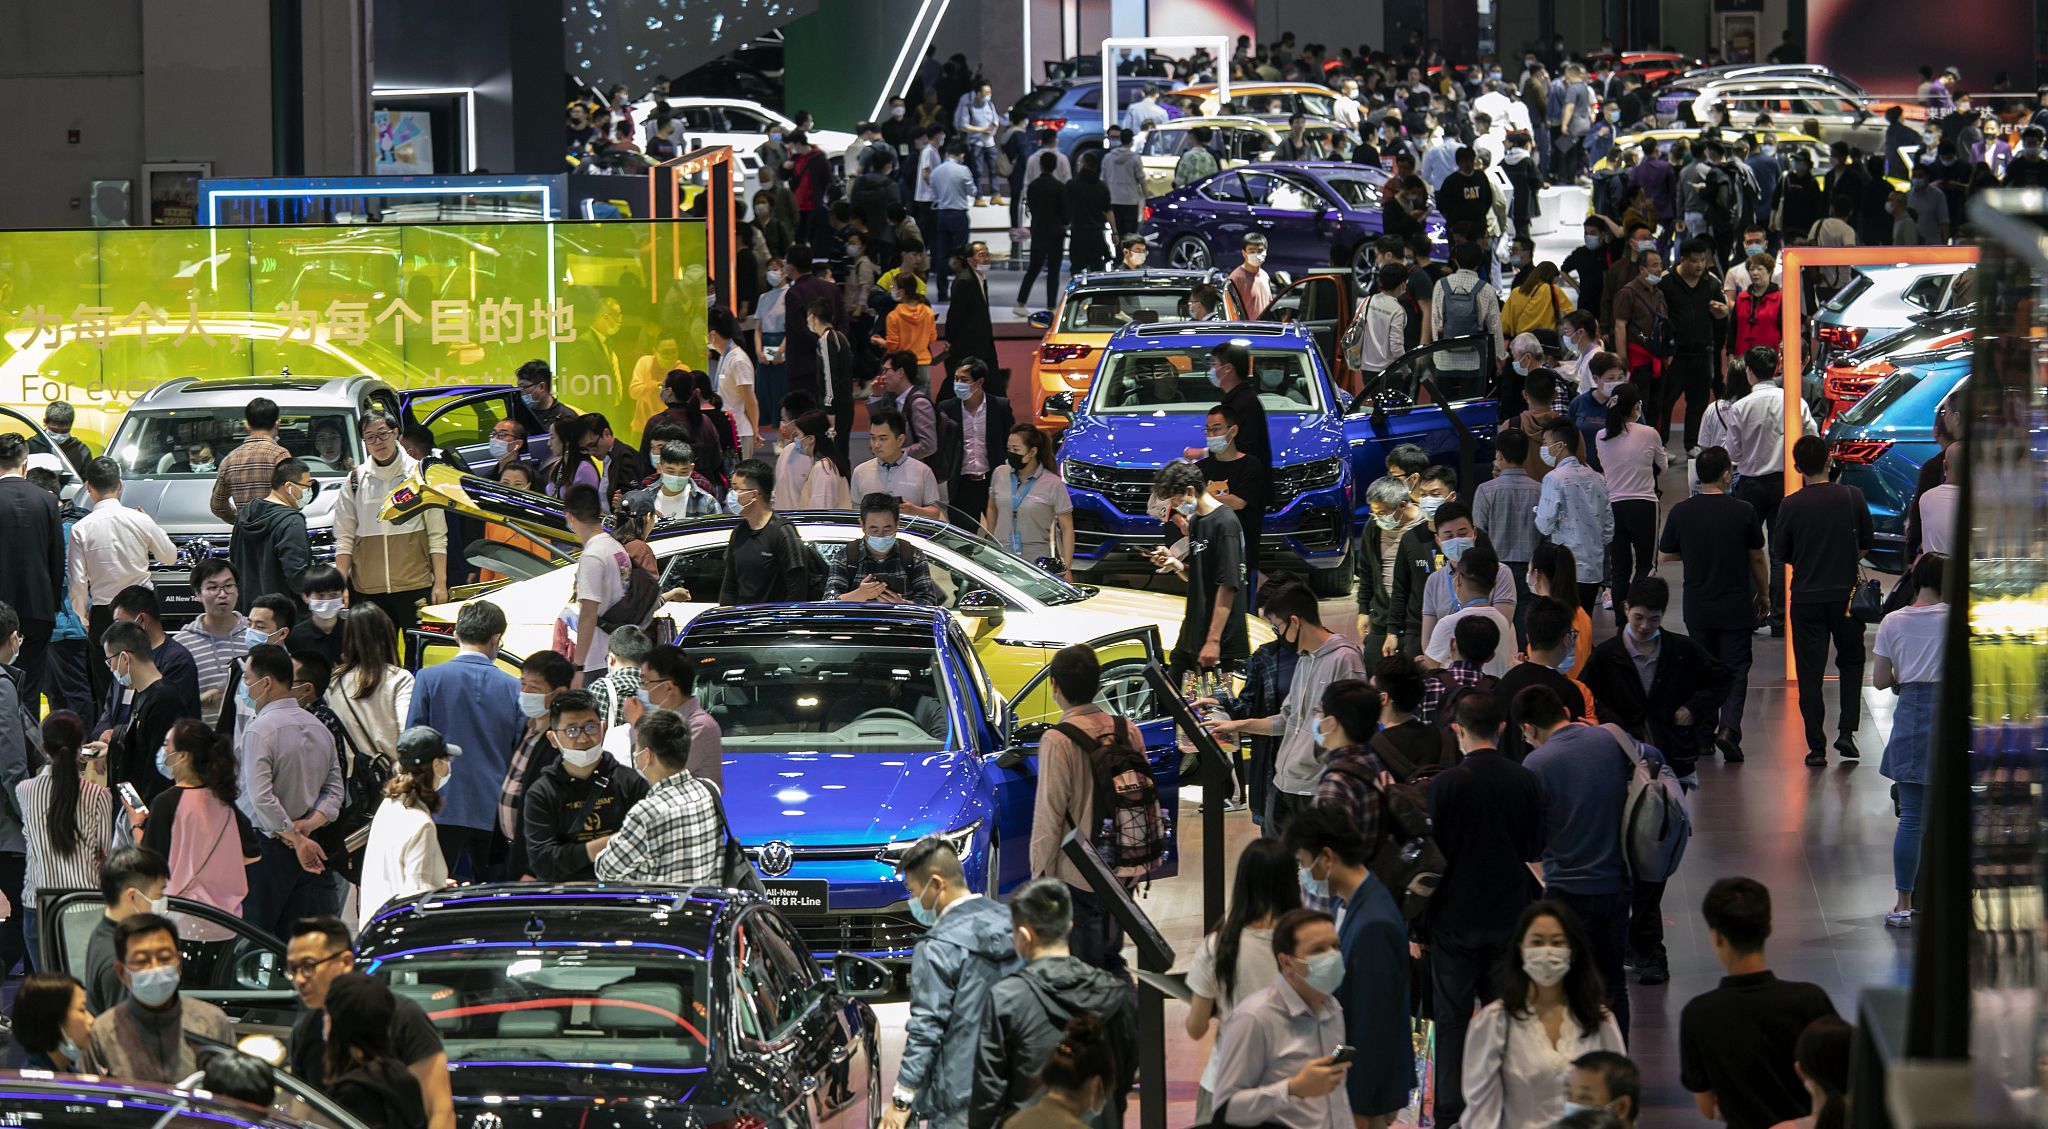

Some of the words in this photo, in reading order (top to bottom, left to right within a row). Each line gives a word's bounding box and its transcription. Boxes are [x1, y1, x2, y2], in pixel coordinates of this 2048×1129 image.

[1463, 186, 1480, 199] CAT
[22, 374, 62, 402] For
[766, 888, 799, 896] All-New
[781, 897, 789, 906] 8
[790, 897, 822, 906] R-Line
